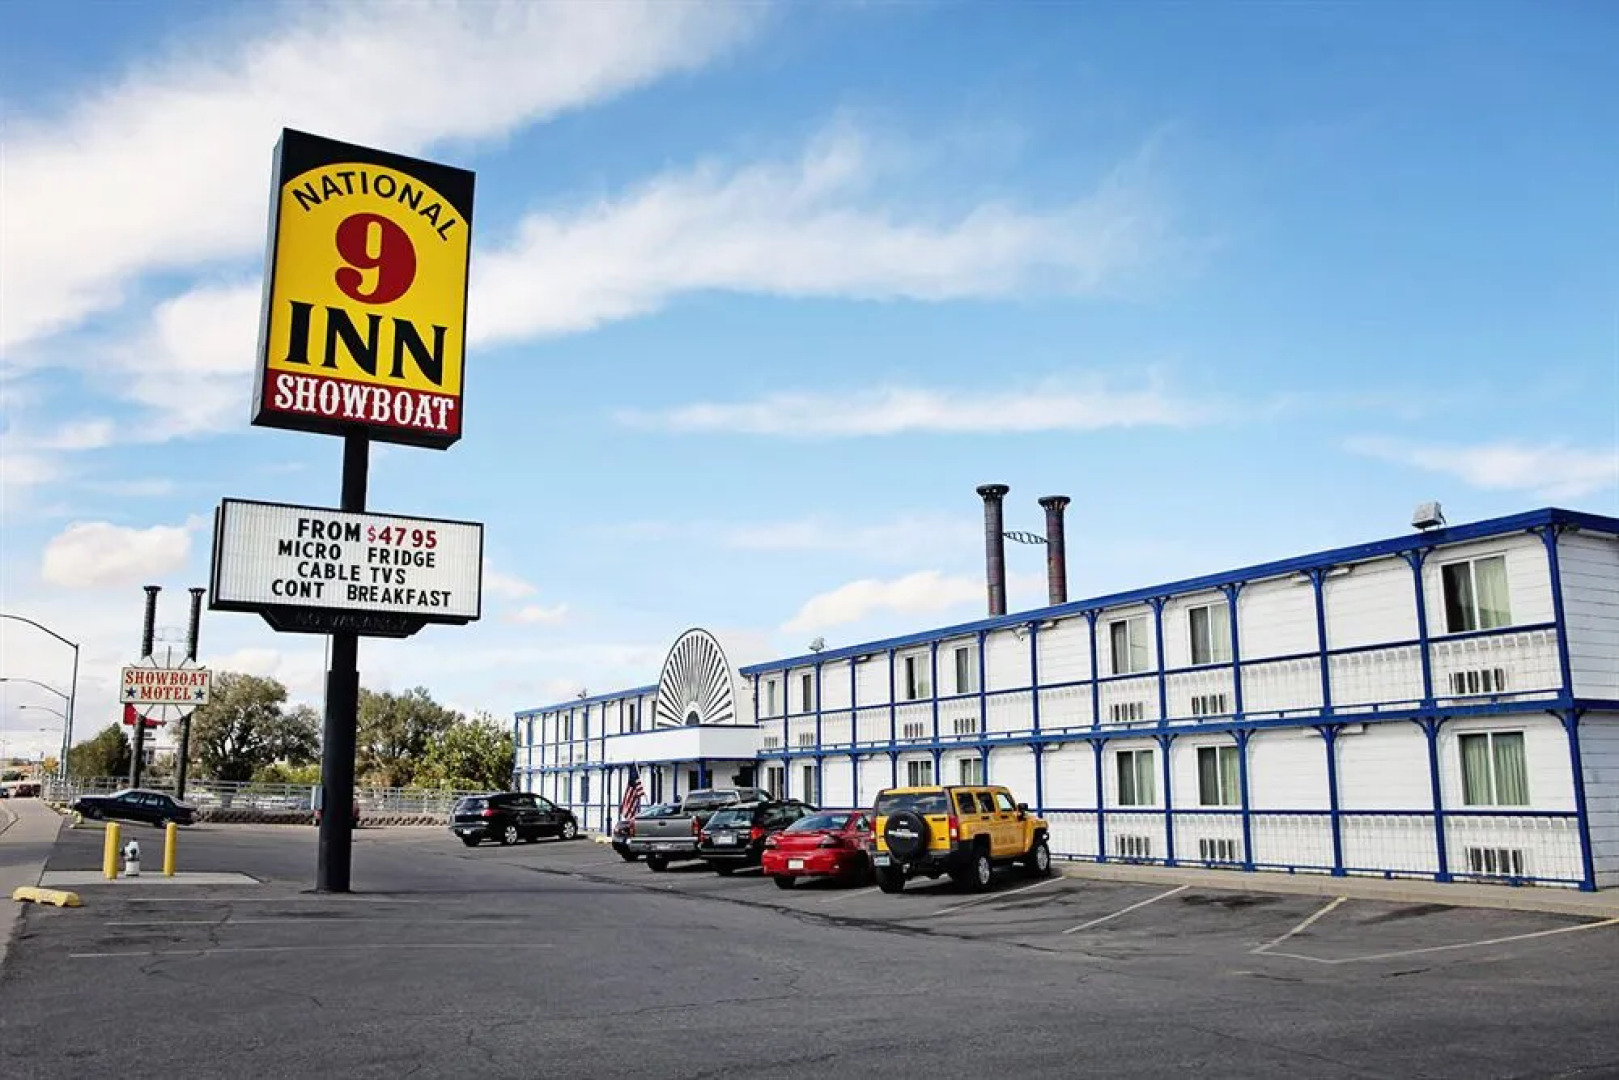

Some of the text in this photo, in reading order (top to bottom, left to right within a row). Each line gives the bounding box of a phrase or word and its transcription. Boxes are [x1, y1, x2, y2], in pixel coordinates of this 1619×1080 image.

[292, 171, 457, 241] NATIONAL
[335, 212, 417, 304] 9
[284, 300, 447, 387] INN
[274, 373, 454, 430] SHOWBOAT
[297, 518, 361, 542] FROM
[278, 539, 435, 568] MICRO FRIDGE
[298, 561, 406, 585] CABLE TVS
[271, 579, 452, 607] CONT BREAKFAST
[125, 670, 208, 686] SHOWBOAT
[140, 686, 191, 700] MOTEL
